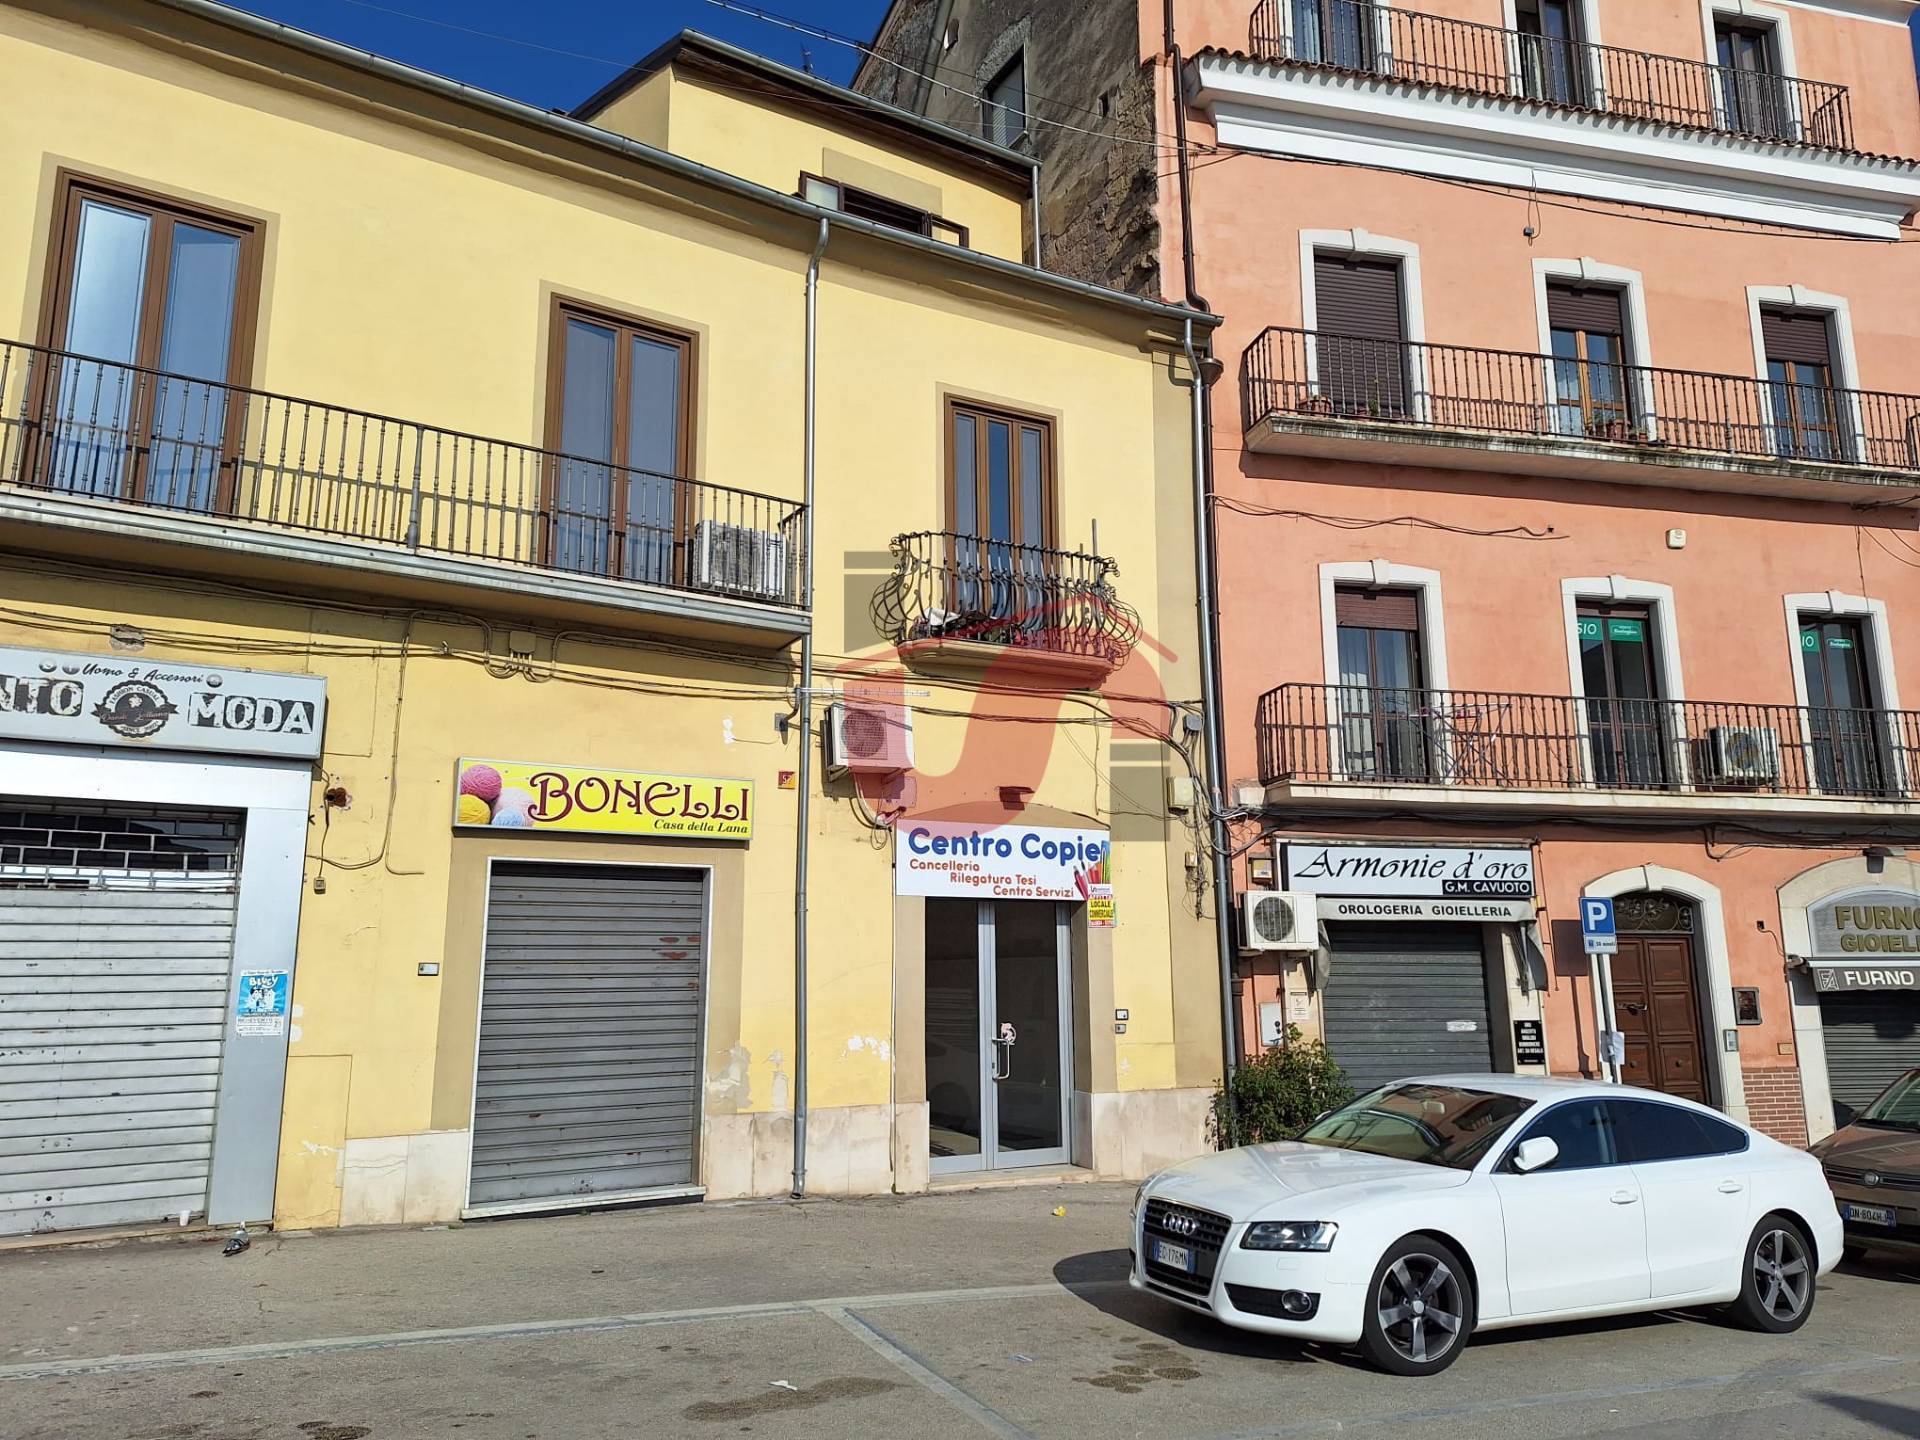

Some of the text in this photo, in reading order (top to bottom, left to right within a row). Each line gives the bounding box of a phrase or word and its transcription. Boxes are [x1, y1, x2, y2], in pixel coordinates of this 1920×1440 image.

[83, 663, 205, 684] Uomo & Accessori
[189, 692, 313, 735] MODA
[527, 772, 749, 822] BONELLI
[654, 819, 748, 834] Casa della Lana
[908, 827, 1100, 867] Centro Copie
[909, 858, 980, 872] Cancelleria
[1294, 848, 1446, 878] Armonie
[950, 872, 1037, 886] Rilegatura Tesi
[993, 885, 1074, 898] Centro Servizi
[1445, 881, 1531, 893] G.M. CAVUOTO
[1090, 900, 1111, 908] LOCALE
[1338, 904, 1512, 917] OROLOGERIA GIOIELLERIA
[1587, 901, 1608, 931] P
[1843, 970, 1915, 986] FURNO
